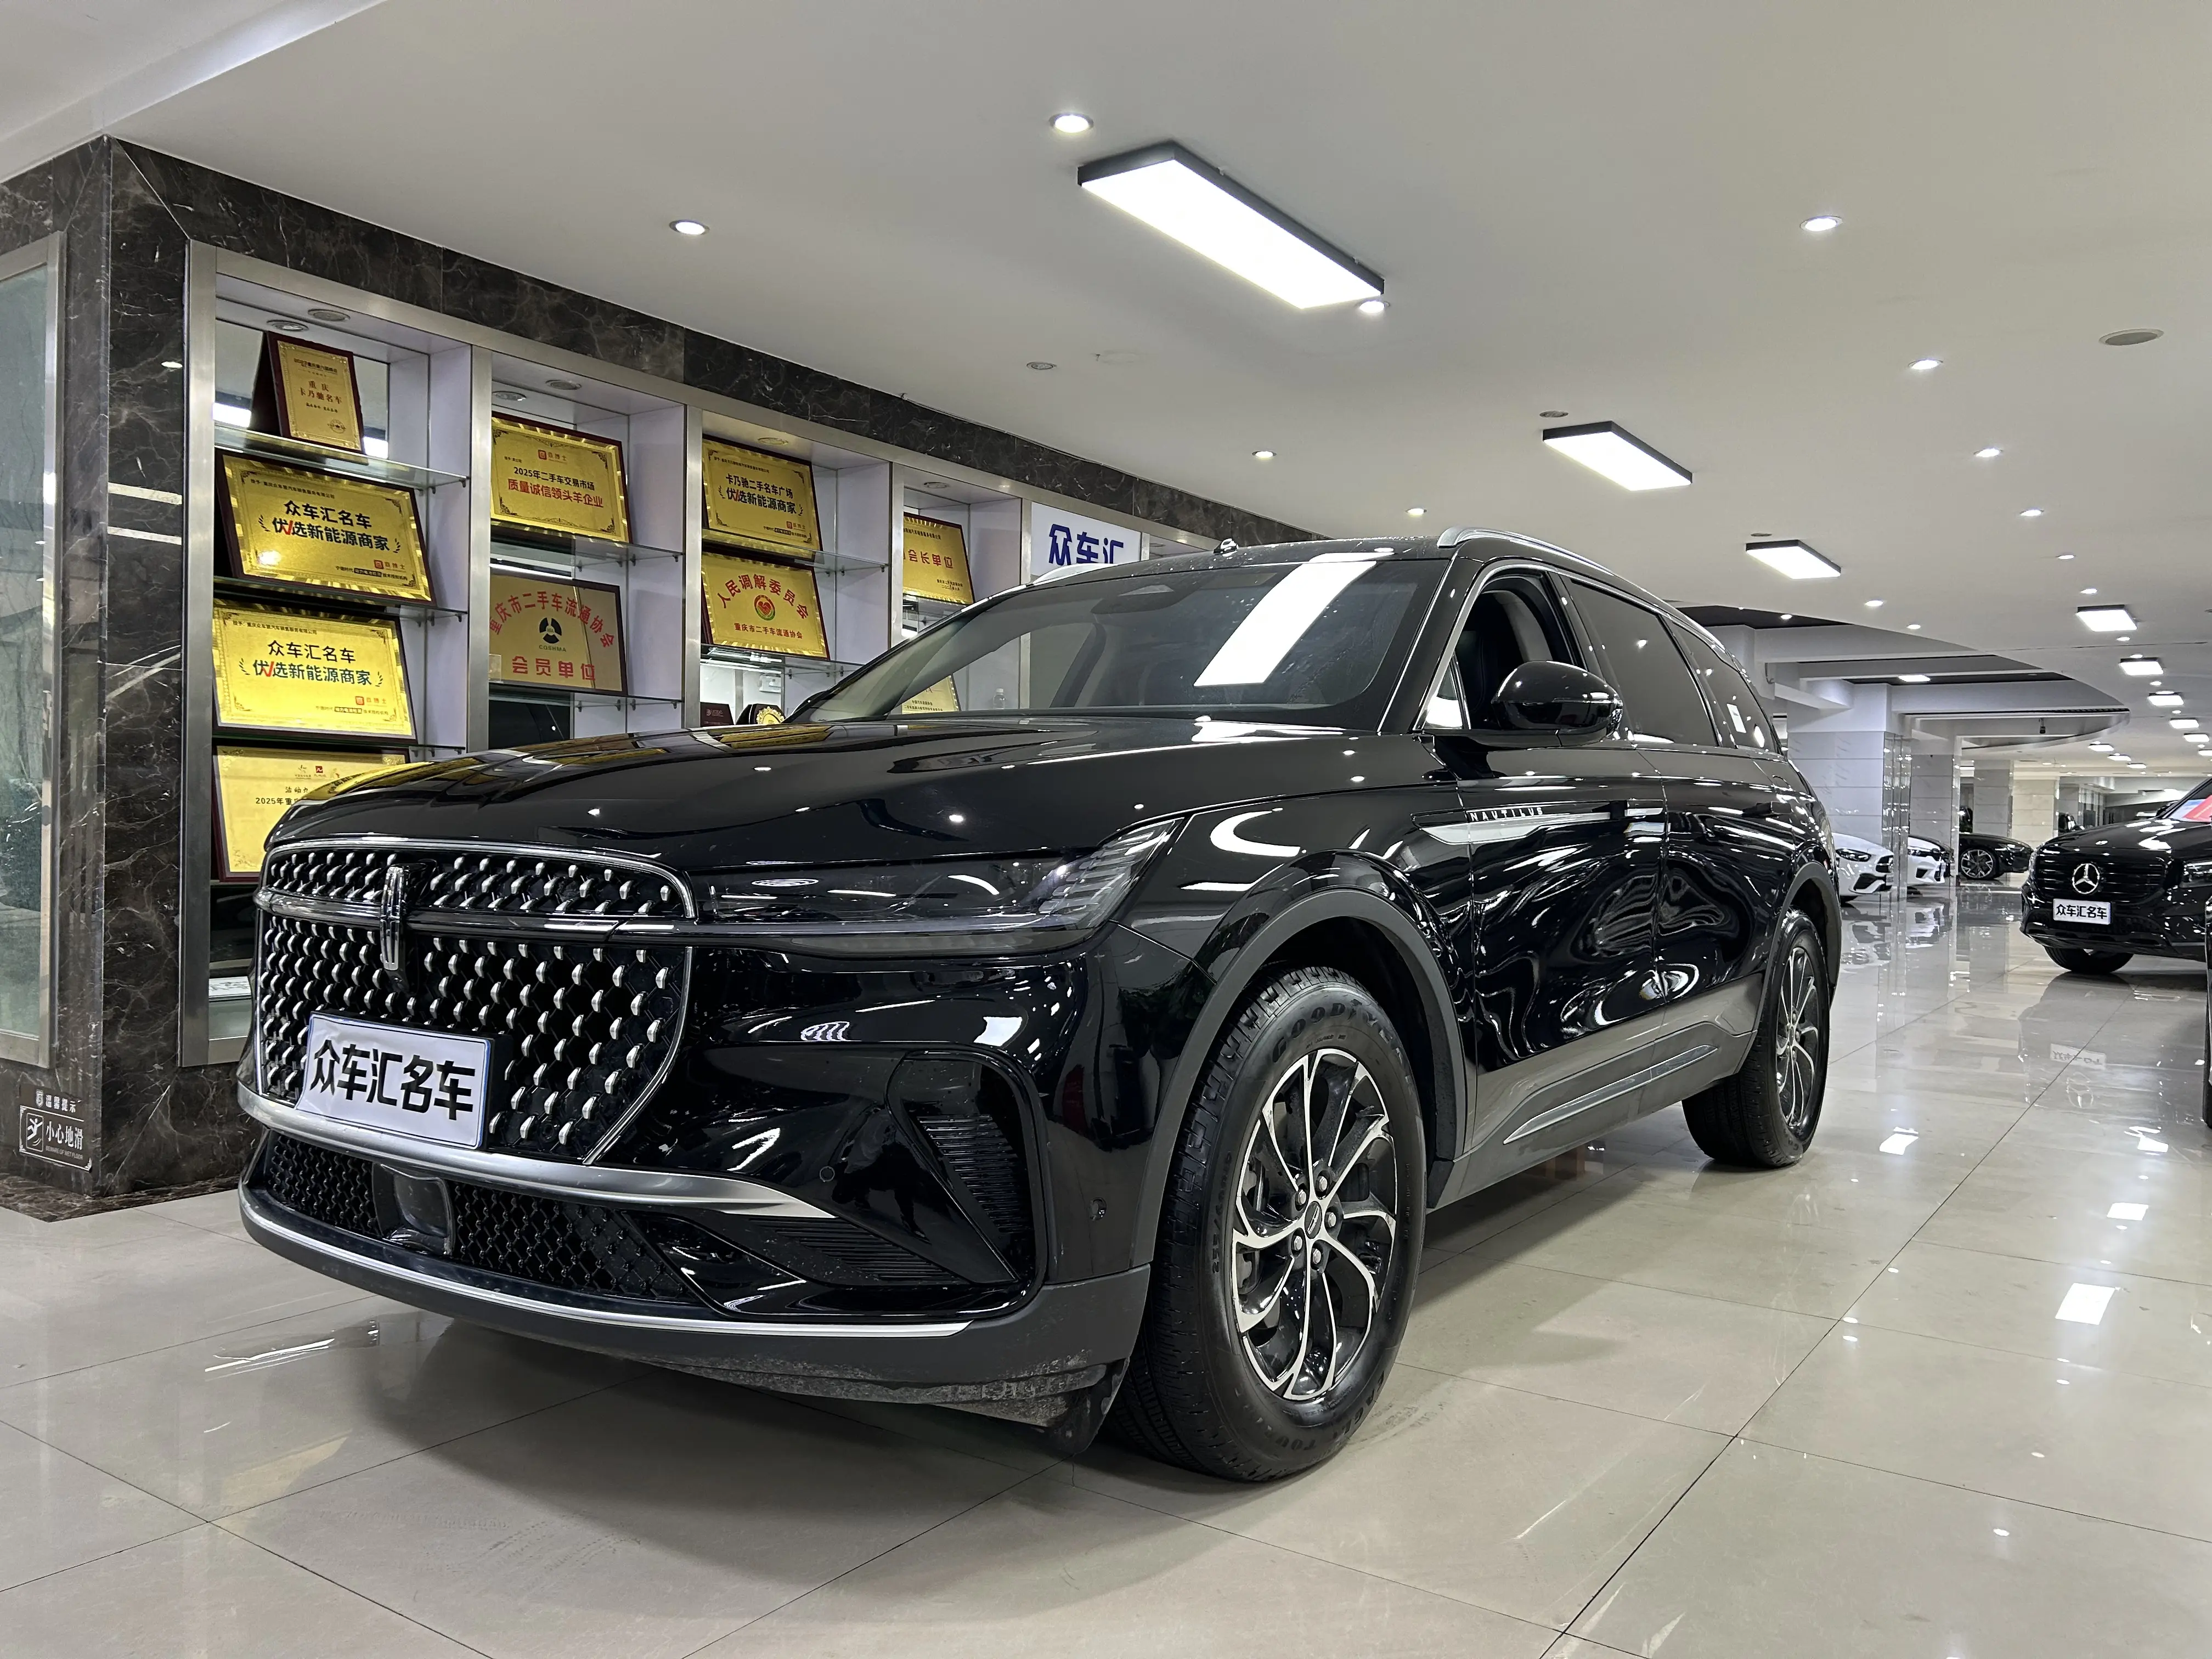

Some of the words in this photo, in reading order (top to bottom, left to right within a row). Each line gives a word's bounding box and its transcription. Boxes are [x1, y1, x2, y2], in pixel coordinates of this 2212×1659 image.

[514, 467, 595, 490] 2025年二手车交易市场
[726, 473, 793, 499] 卡乃驰二手名车广场
[508, 478, 603, 508] 质量诚信领头羊企业
[726, 487, 797, 514] 优选新能源商家
[284, 500, 372, 529] 众车汇名车
[272, 517, 390, 551] 优选新能源商家
[1049, 523, 1124, 566] 众车汇
[904, 549, 953, 569] 会长单位
[717, 573, 808, 619] 人民调解委员会
[489, 591, 614, 647] 重庆市二手车流通协会
[734, 623, 803, 639] 重庆市二手车流通协会
[268, 640, 356, 663] 众车汇名车
[253, 659, 371, 685] 优选新能源商家
[512, 656, 595, 681] 会员单位
[1469, 806, 1543, 822] NAUTILUS
[2056, 904, 2107, 919] 众车汇名车
[309, 1040, 476, 1120] 众车汇名车
[46, 1094, 76, 1113] 温馨提示
[46, 1121, 83, 1150] 小心地滑
